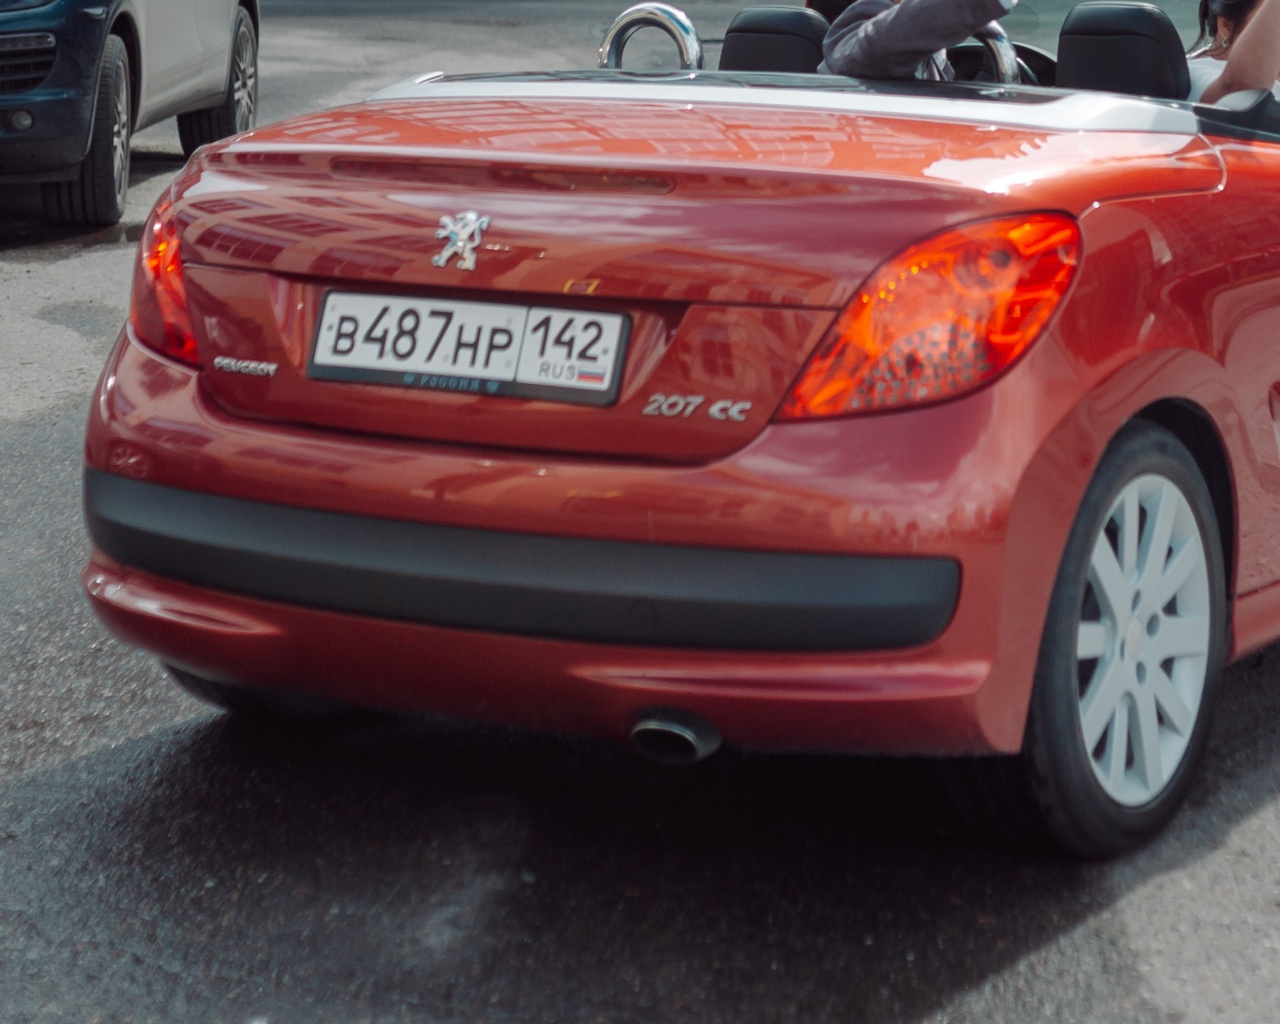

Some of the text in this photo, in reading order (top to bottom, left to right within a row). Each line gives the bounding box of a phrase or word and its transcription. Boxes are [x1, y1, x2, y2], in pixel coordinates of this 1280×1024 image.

[331, 305, 604, 370] В487НР 142
[539, 361, 577, 381] RUS
[642, 392, 705, 418] 207
